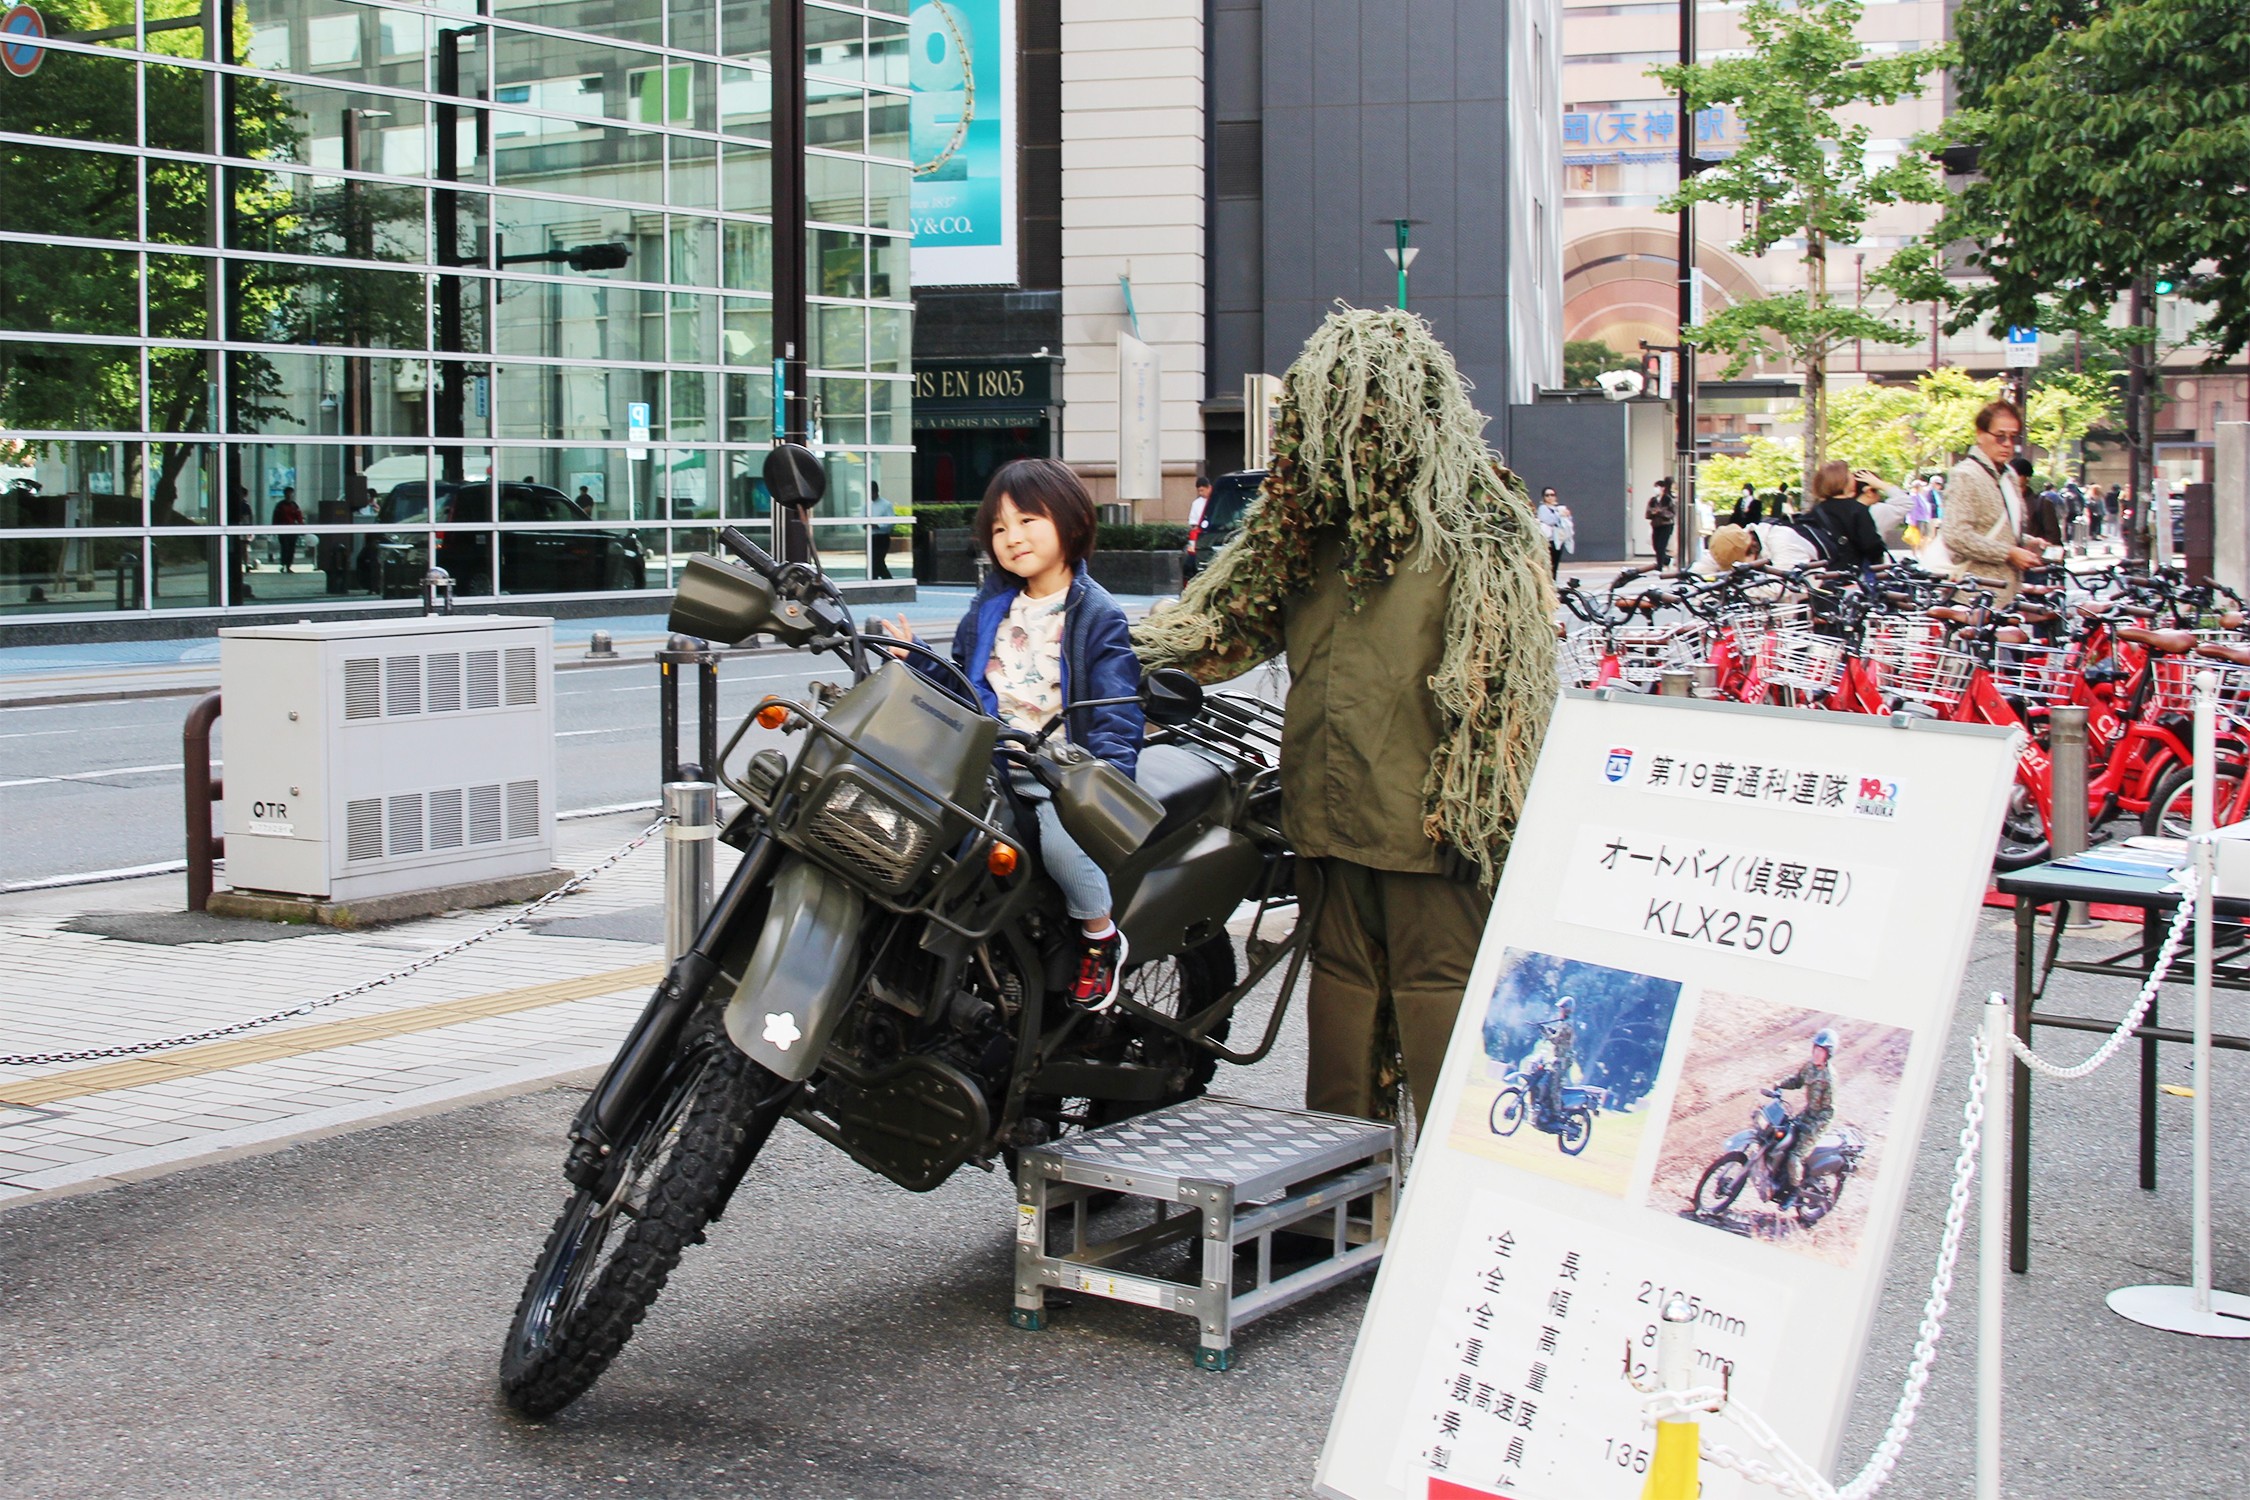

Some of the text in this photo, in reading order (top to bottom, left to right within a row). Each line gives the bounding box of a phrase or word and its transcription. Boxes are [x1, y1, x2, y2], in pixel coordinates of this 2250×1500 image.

[911, 370, 1025, 398] IS EN 1803
[1647, 754, 1848, 808] 第19普通科連隊
[1643, 898, 1793, 955] KLX250
